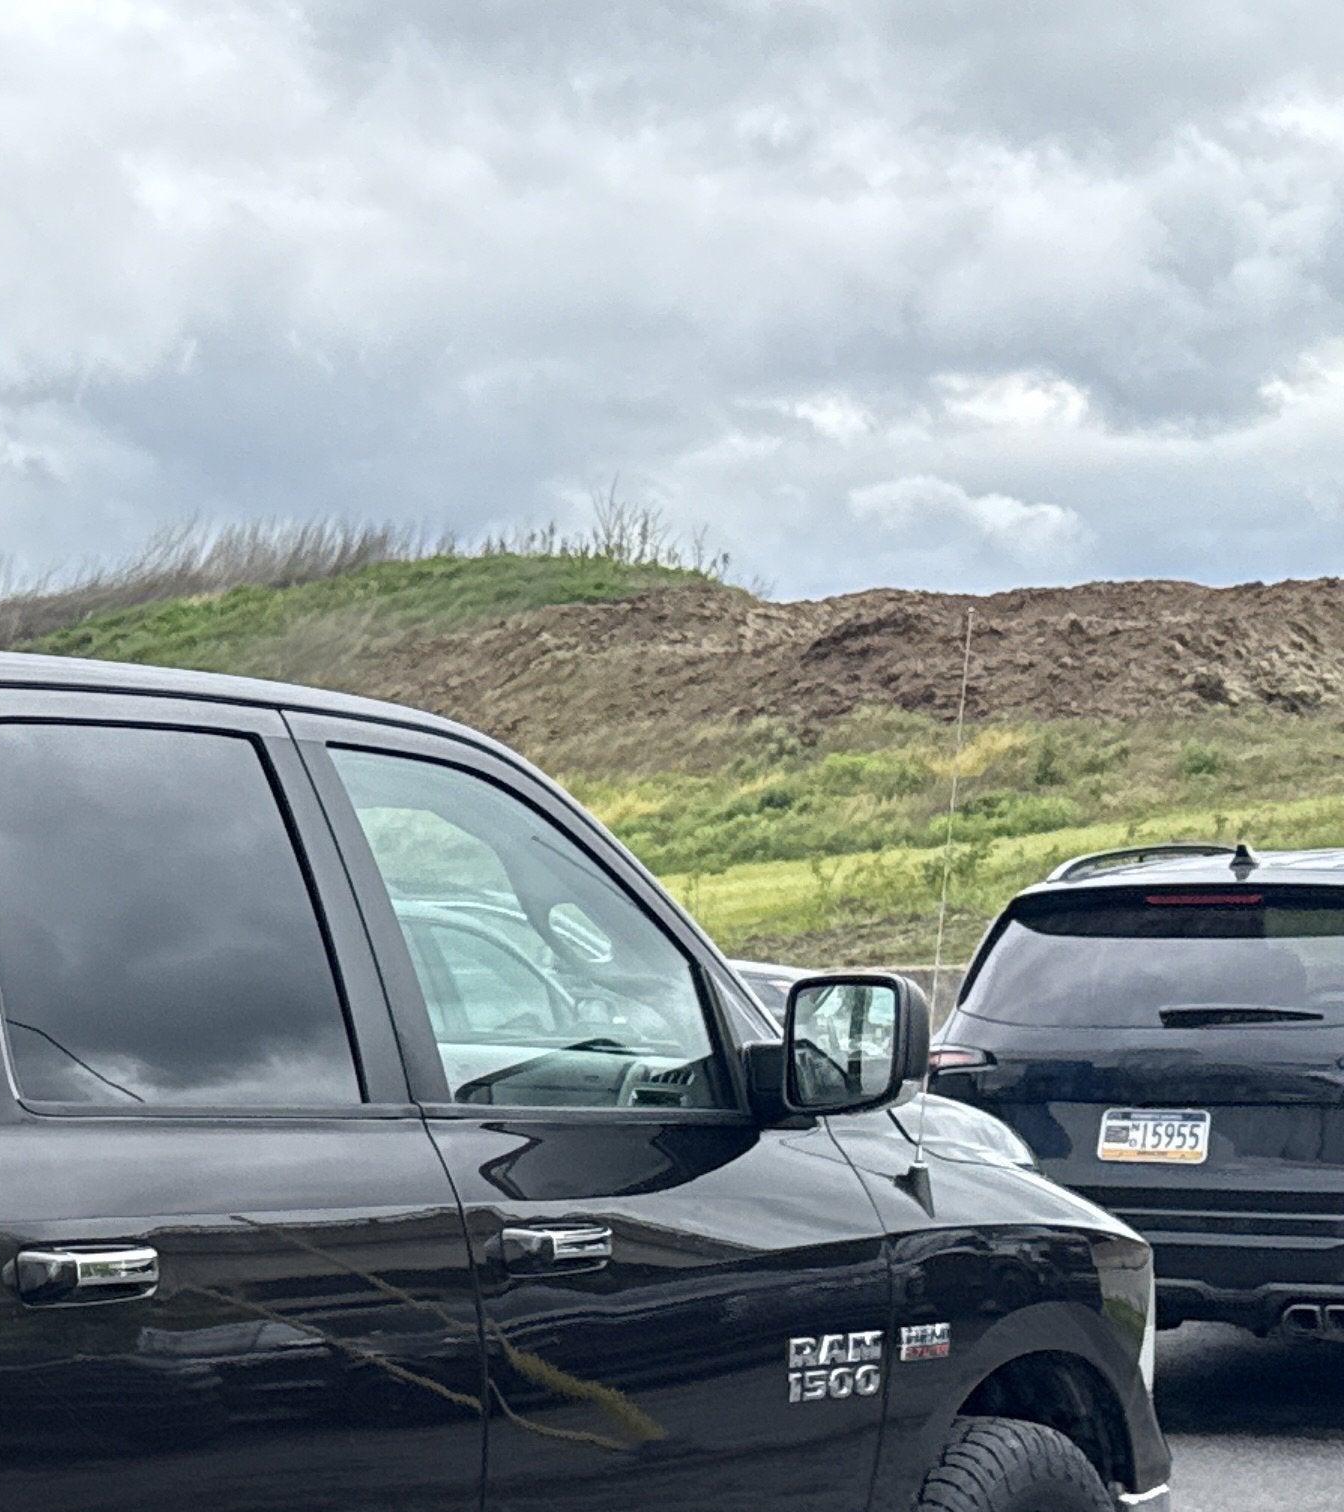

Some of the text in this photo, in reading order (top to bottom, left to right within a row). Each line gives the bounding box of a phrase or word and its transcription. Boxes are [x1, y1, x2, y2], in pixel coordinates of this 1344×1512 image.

[1141, 1122, 1201, 1150] 15955
[789, 1330, 885, 1368] RAM
[788, 1364, 881, 1403] 1500
